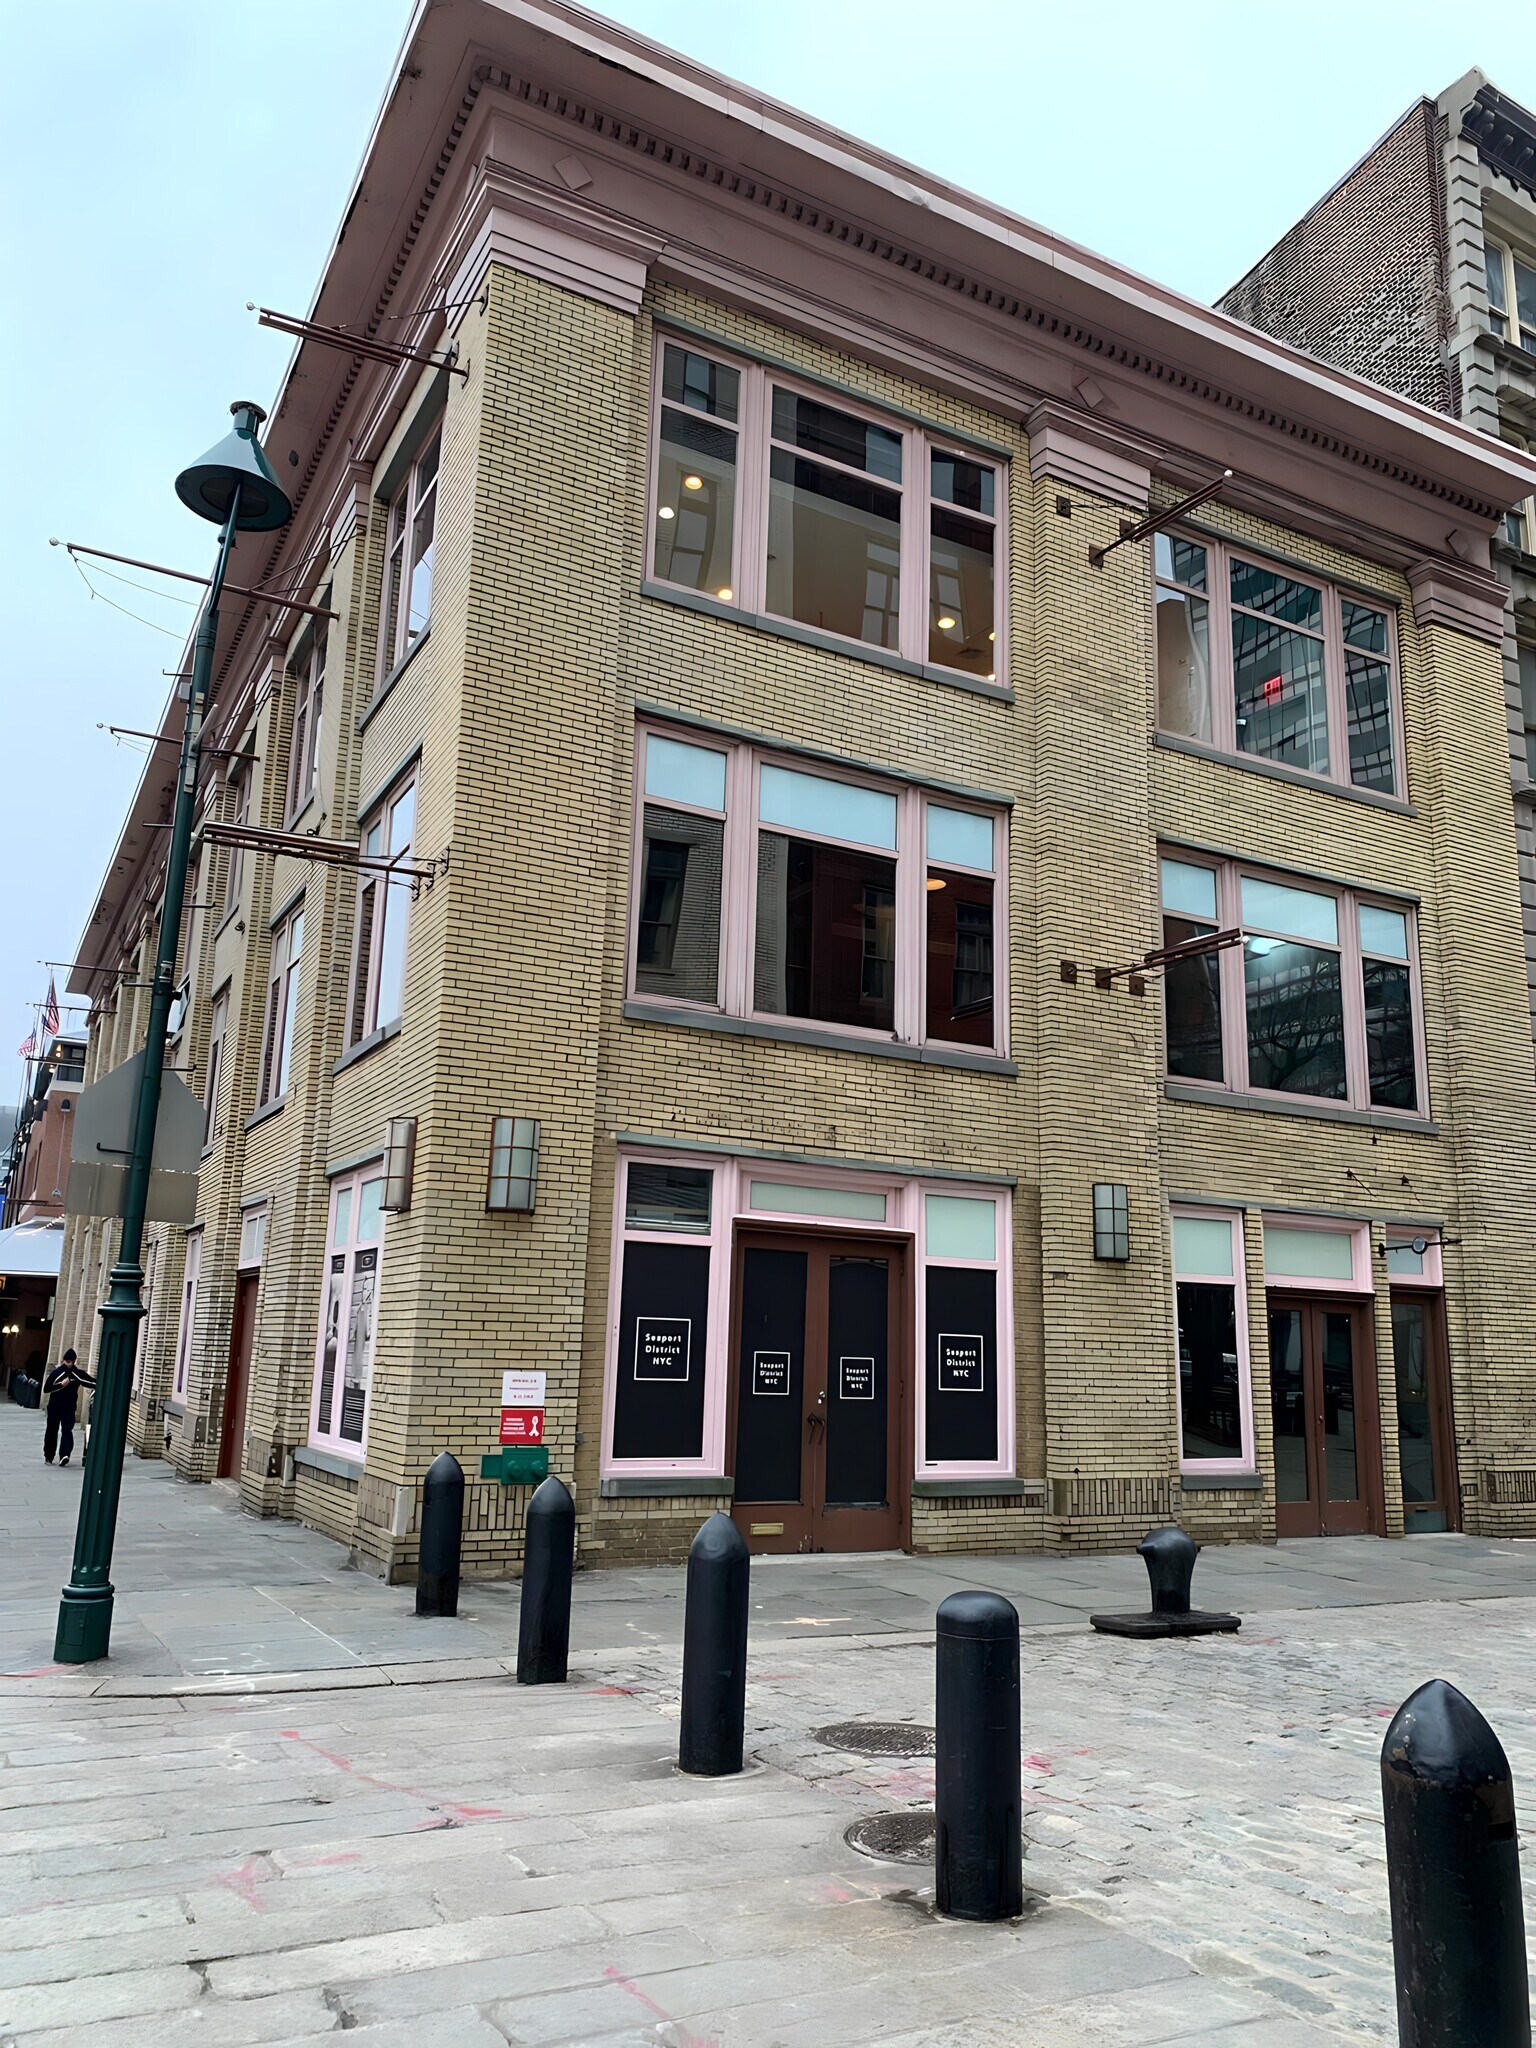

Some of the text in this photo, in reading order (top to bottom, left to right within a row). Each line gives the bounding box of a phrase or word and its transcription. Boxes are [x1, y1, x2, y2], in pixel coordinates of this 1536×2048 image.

[645, 1333, 682, 1344] Seaport
[645, 1345, 680, 1354] District
[652, 1357, 672, 1366] NYC
[952, 1369, 969, 1378] NYC
